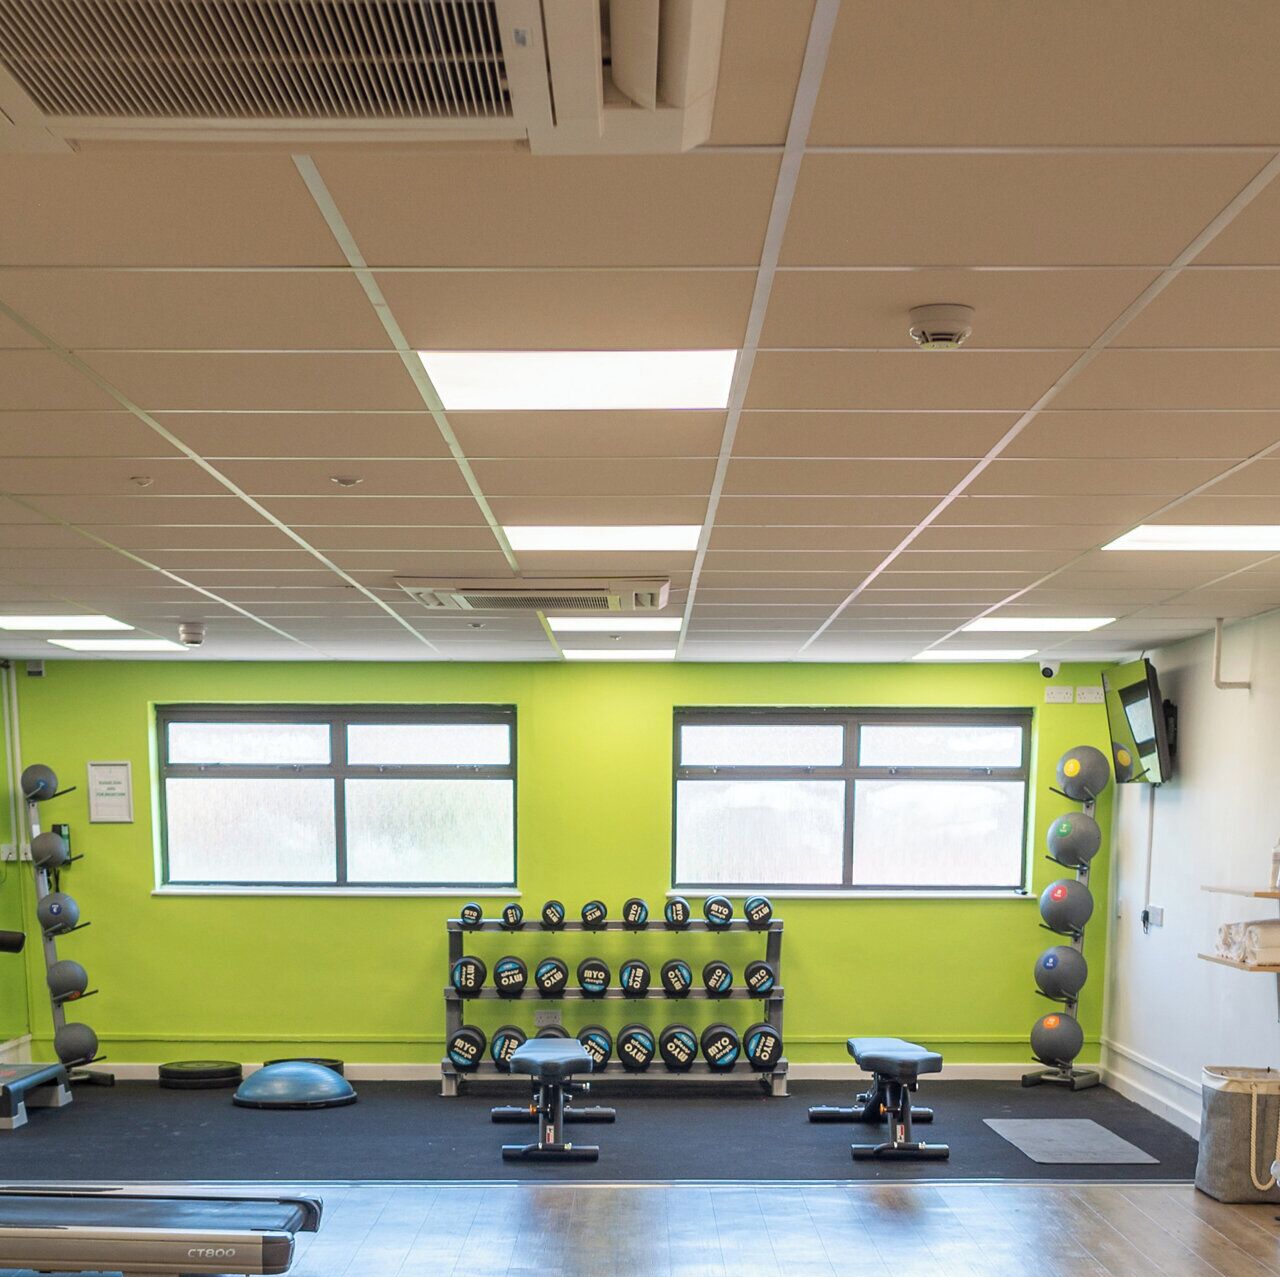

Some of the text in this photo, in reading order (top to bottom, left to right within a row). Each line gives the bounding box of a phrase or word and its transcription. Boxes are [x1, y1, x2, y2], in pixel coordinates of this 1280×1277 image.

[752, 906, 769, 920] MYO
[466, 964, 475, 987] MYO
[501, 973, 523, 985] MYO
[544, 971, 563, 987] MYO
[583, 969, 605, 979] MYO
[633, 967, 643, 988] MYO
[667, 970, 682, 990] MYO
[708, 969, 722, 987] MYO
[749, 969, 766, 985] MYO
[454, 1038, 477, 1054] MYO
[624, 1043, 646, 1062] MYO
[667, 1042, 688, 1062] MYO
[707, 1037, 729, 1056] MYO
[760, 1036, 775, 1060] MYO
[187, 1248, 236, 1258] CT800
